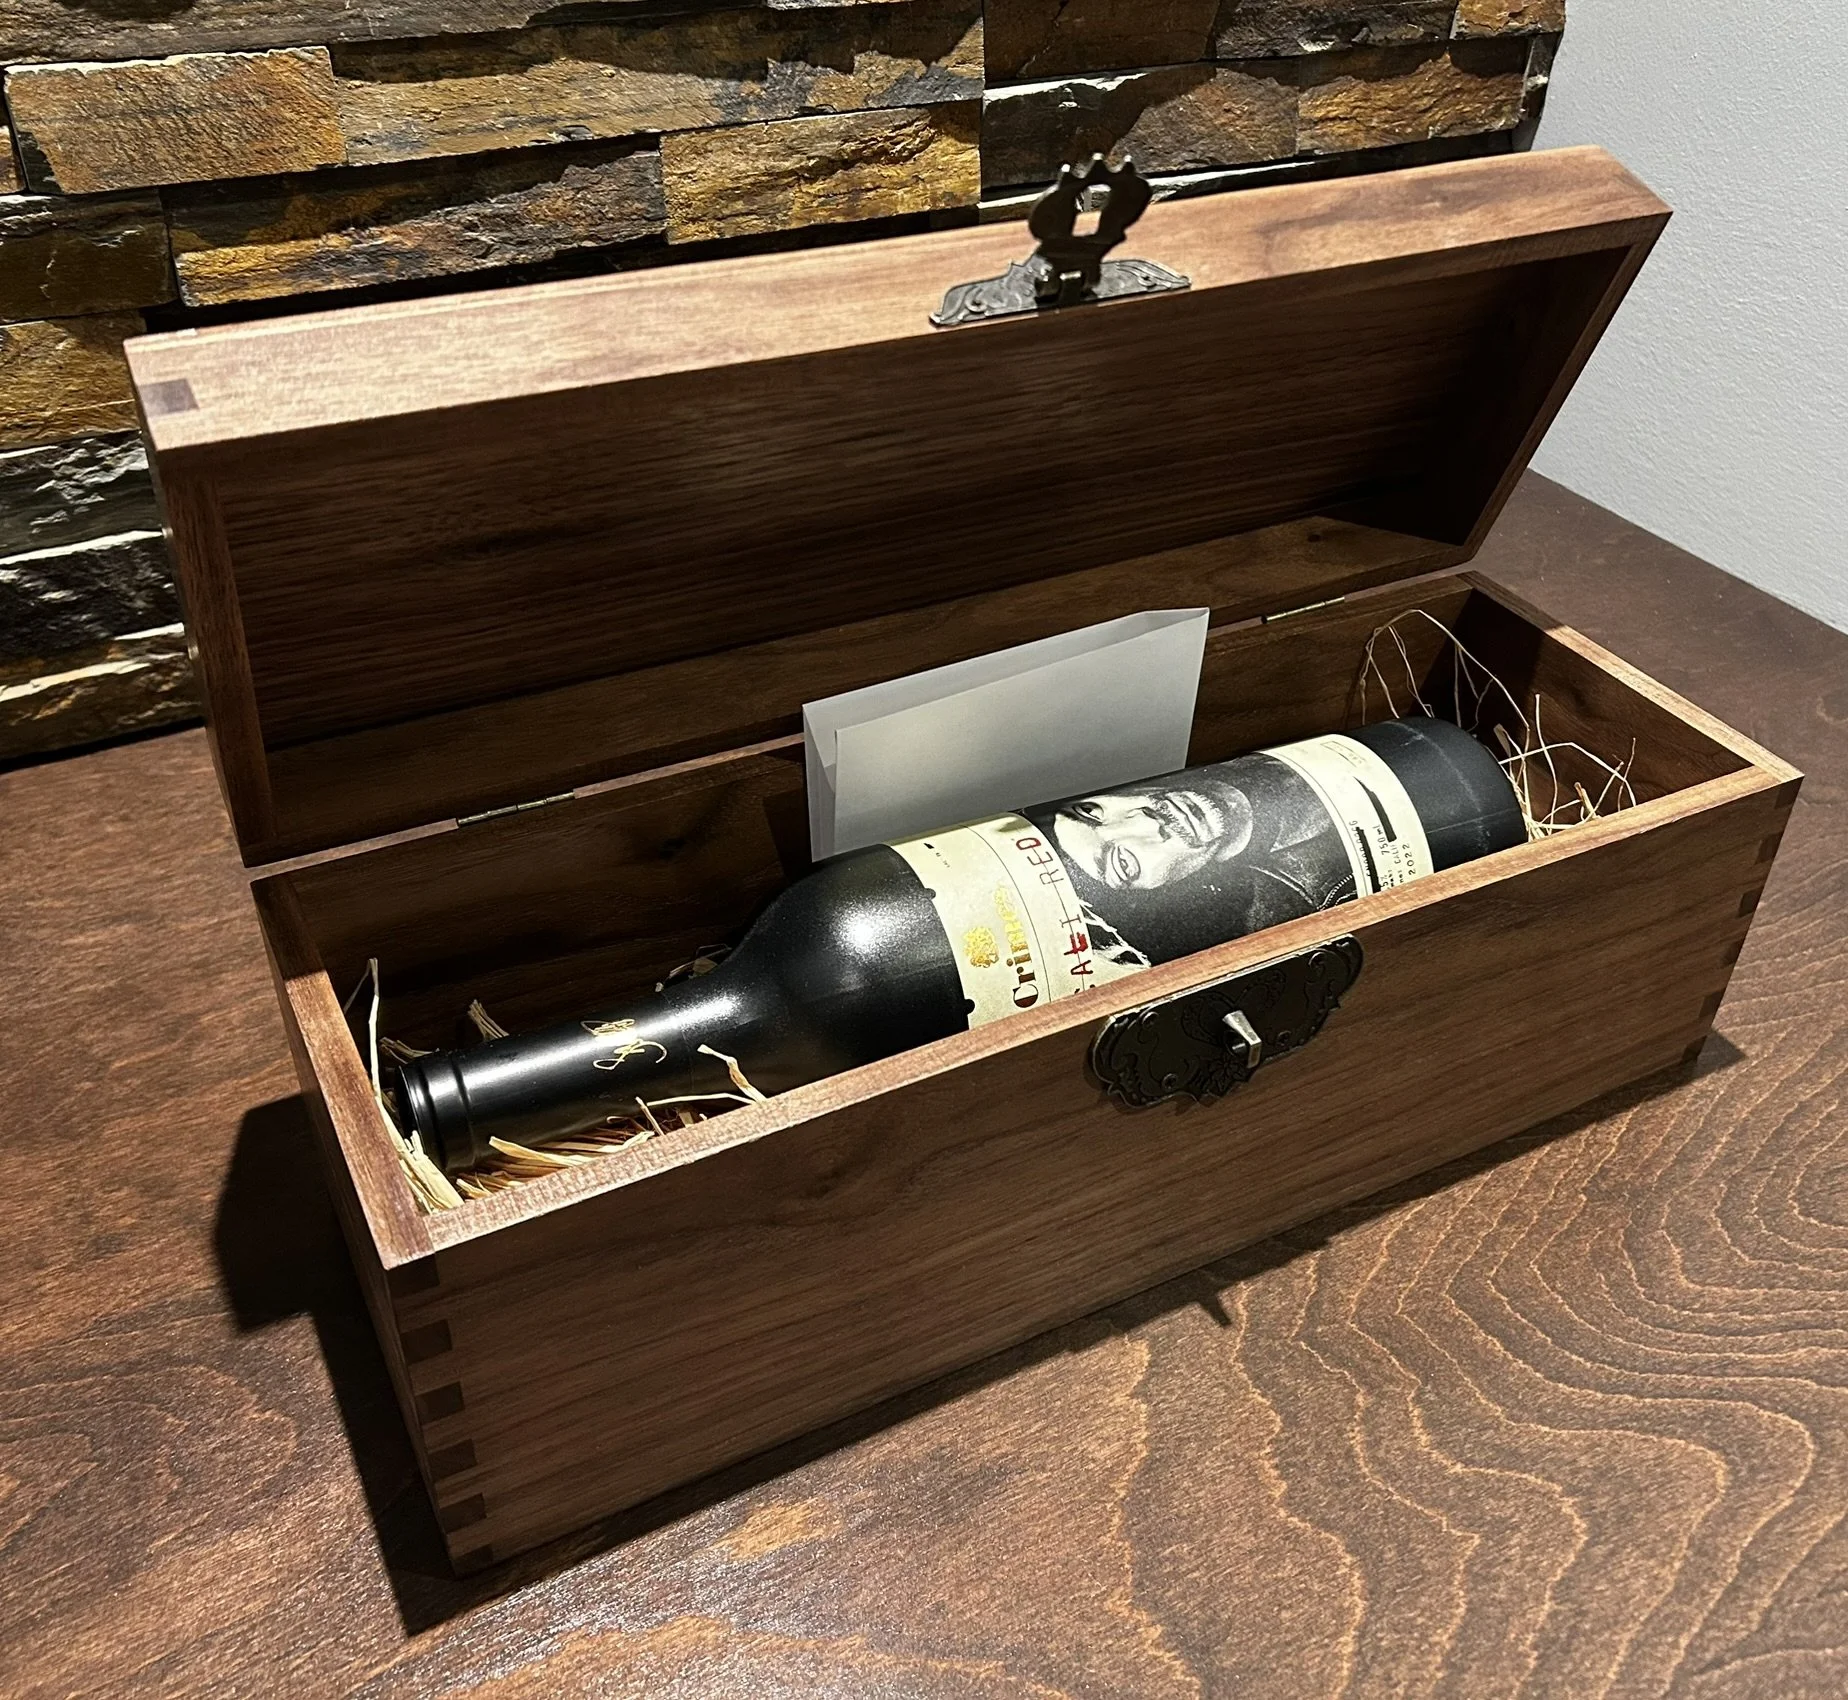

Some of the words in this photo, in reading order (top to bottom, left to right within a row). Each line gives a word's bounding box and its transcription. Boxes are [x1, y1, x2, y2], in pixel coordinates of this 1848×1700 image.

[1015, 837, 1064, 885] RED
[1402, 843, 1416, 876] 2022
[994, 886, 1039, 1008] Crim
